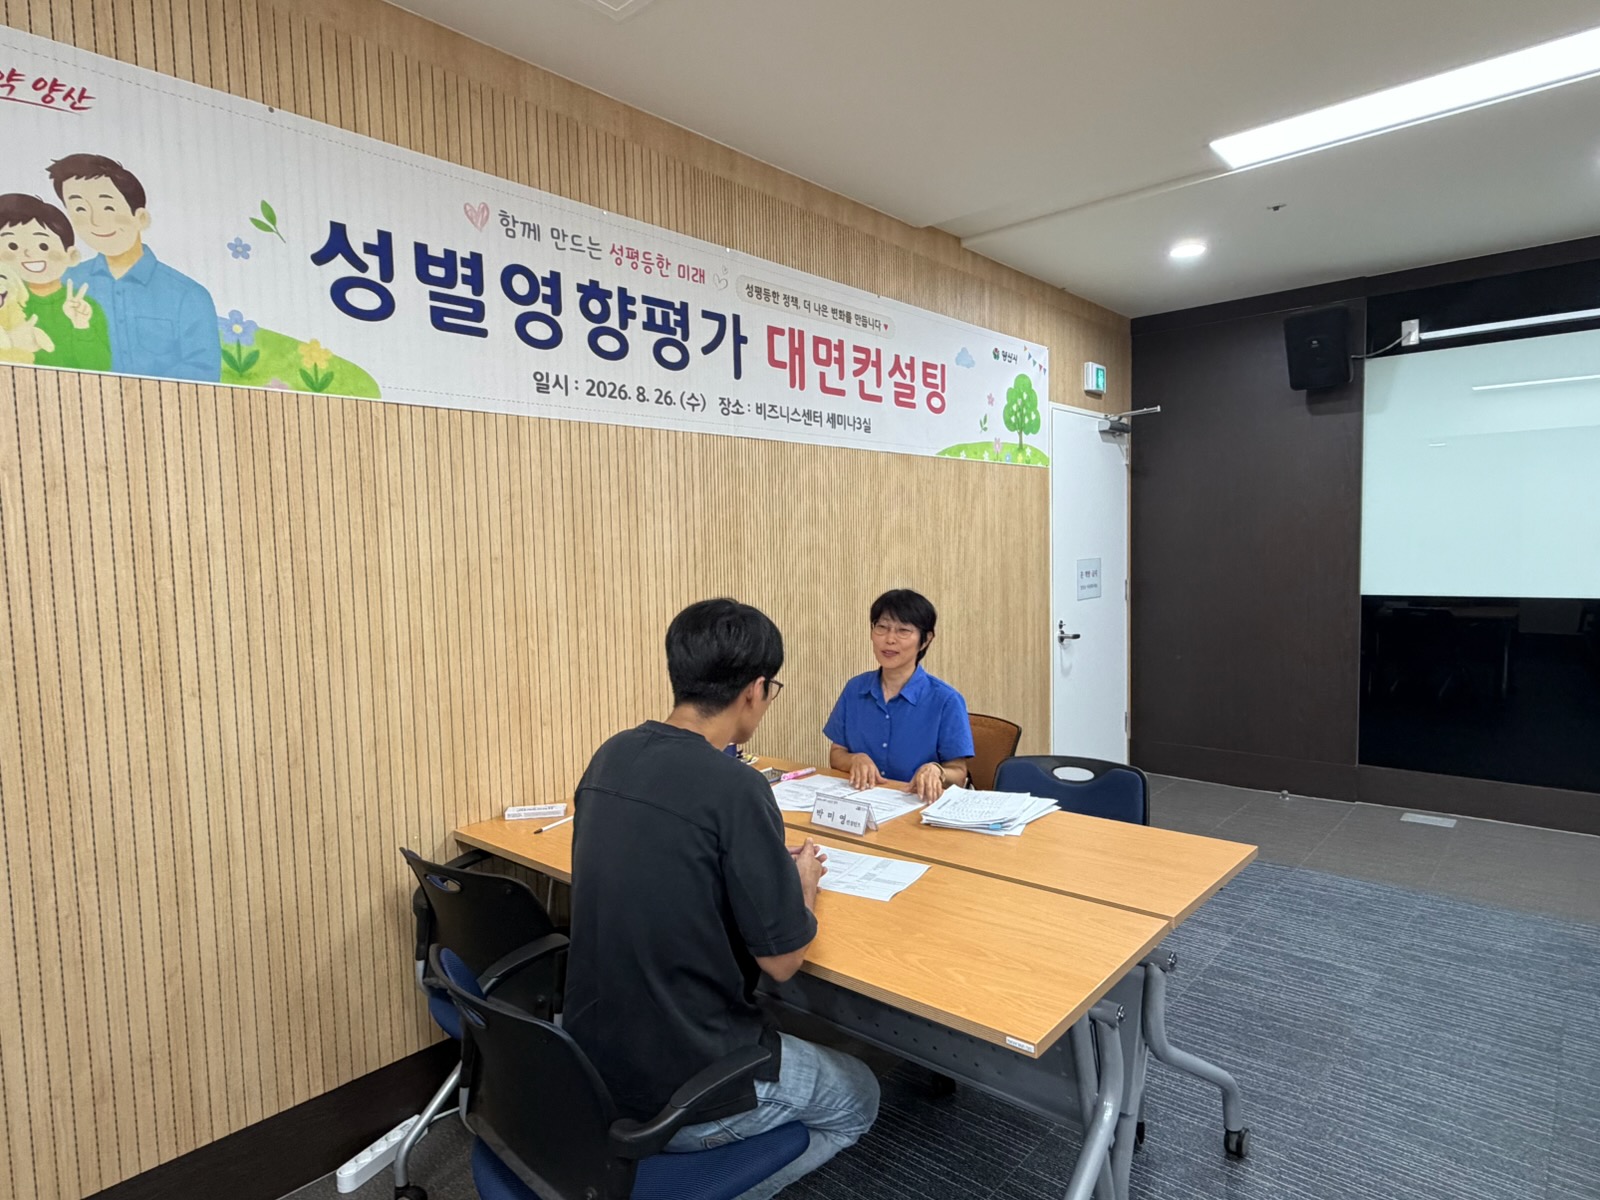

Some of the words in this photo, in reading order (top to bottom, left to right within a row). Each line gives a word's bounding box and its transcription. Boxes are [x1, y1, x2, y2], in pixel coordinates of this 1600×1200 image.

[31, 77, 96, 111] 양산
[498, 209, 541, 242] 함께
[550, 227, 602, 260] 만드는
[609, 243, 671, 278] 성평등한
[677, 264, 705, 284] 미래
[310, 220, 748, 381] 성별영향평가
[767, 325, 947, 415] 대면컨설팅
[745, 283, 780, 305] 성평등한
[803, 299, 811, 313] 더
[813, 302, 829, 318] 나은
[831, 307, 853, 325] 변화를
[854, 313, 882, 332] 만듭니다
[585, 378, 632, 401] 2026.
[636, 385, 650, 403] 8.
[755, 402, 823, 428] 비즈니스센터
[826, 411, 872, 434] 세미나3실
